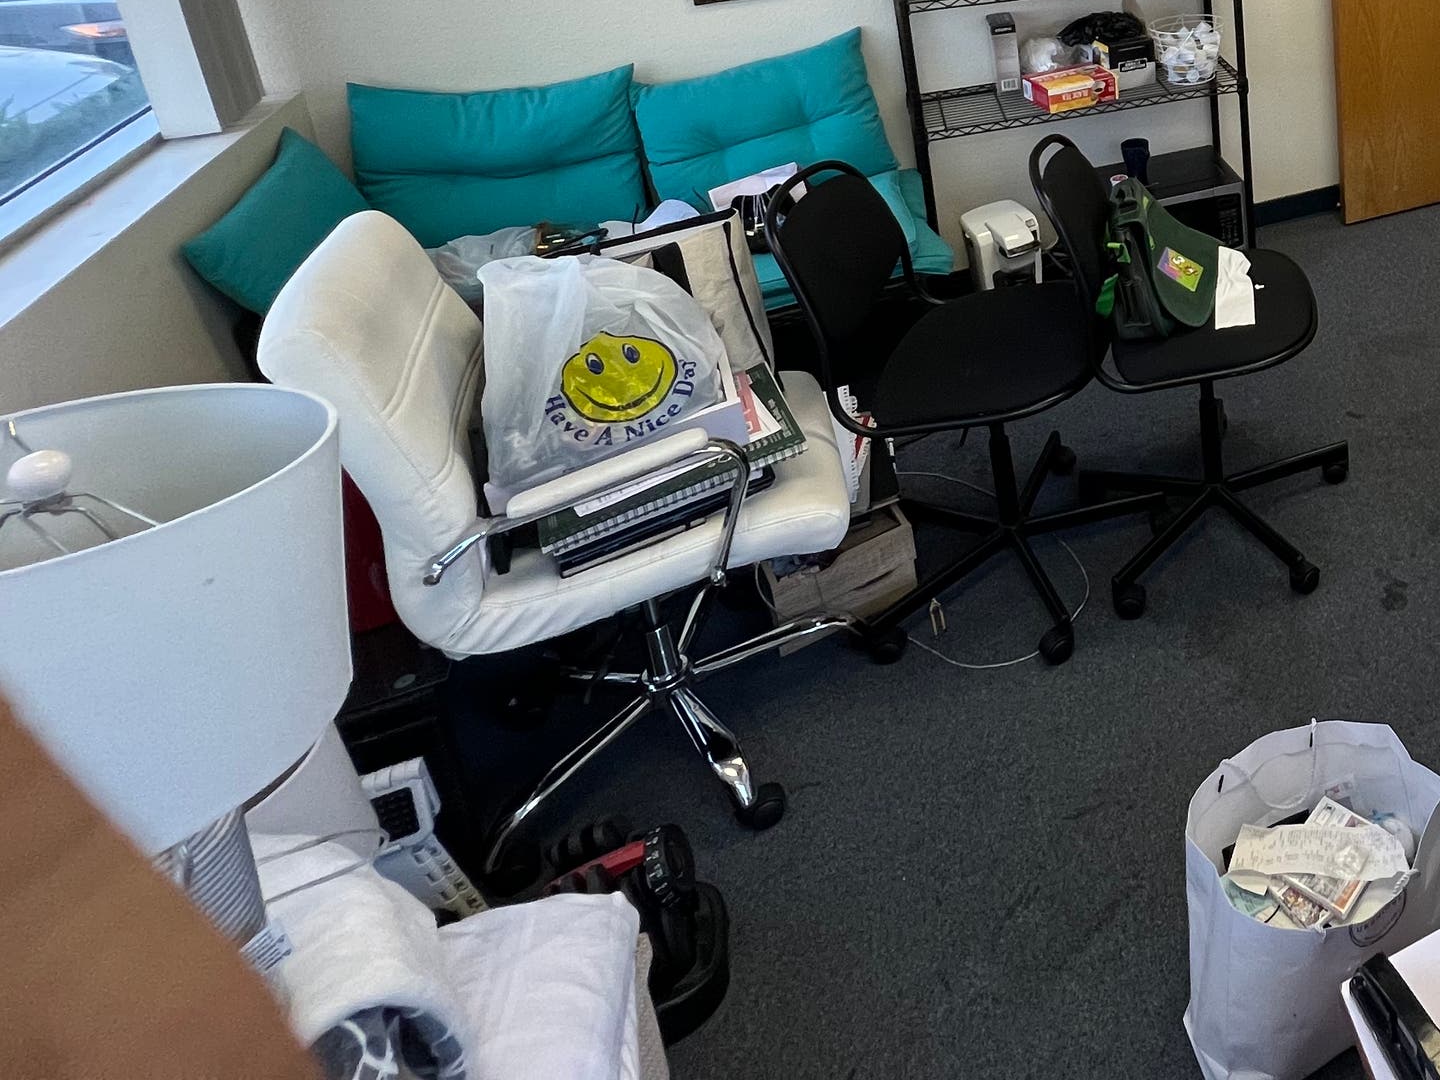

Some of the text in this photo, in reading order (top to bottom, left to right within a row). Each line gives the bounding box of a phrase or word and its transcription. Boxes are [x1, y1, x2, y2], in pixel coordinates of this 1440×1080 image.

[544, 394, 590, 442] Have
[594, 426, 613, 446] A
[624, 403, 682, 442] Nice
